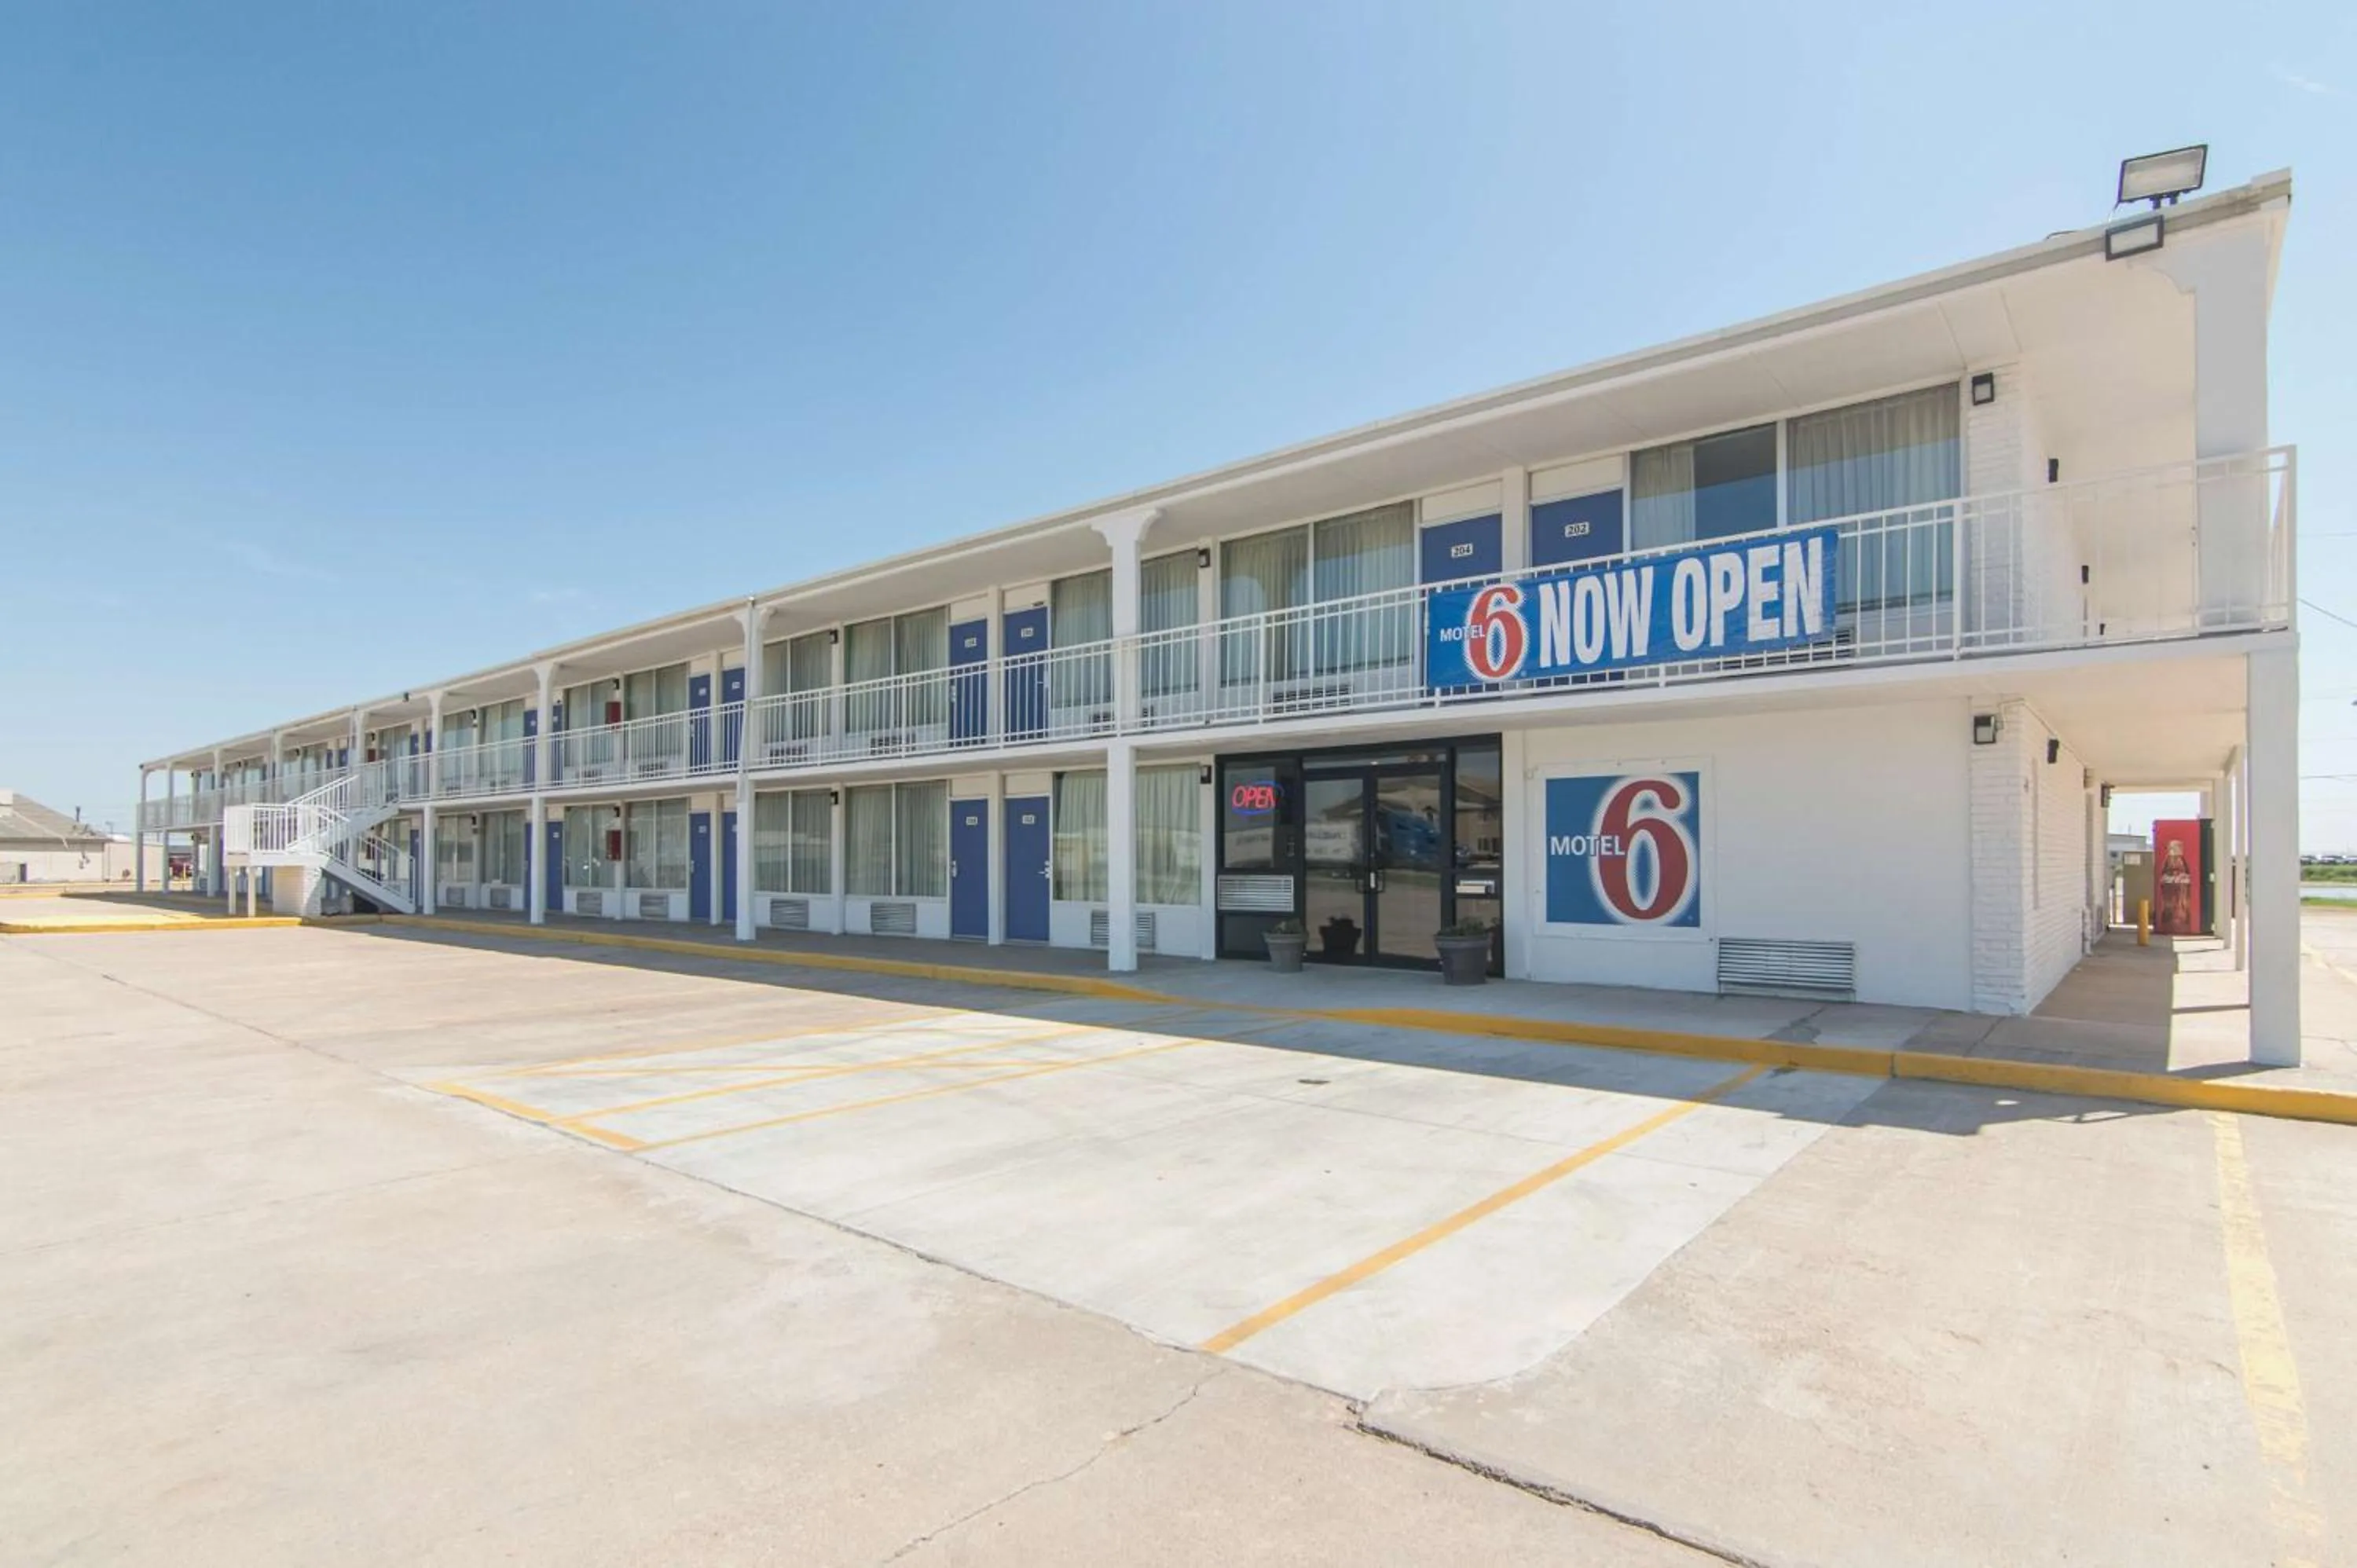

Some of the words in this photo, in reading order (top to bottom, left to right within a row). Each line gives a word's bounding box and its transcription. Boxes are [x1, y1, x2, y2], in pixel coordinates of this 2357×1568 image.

[1439, 625, 1485, 642] MOTEL
[1467, 585, 1523, 679] 6
[1539, 566, 1653, 668] NOW
[1672, 537, 1824, 652] OPEN
[1550, 835, 1626, 855] MOTEL
[1597, 779, 1688, 920] 6
